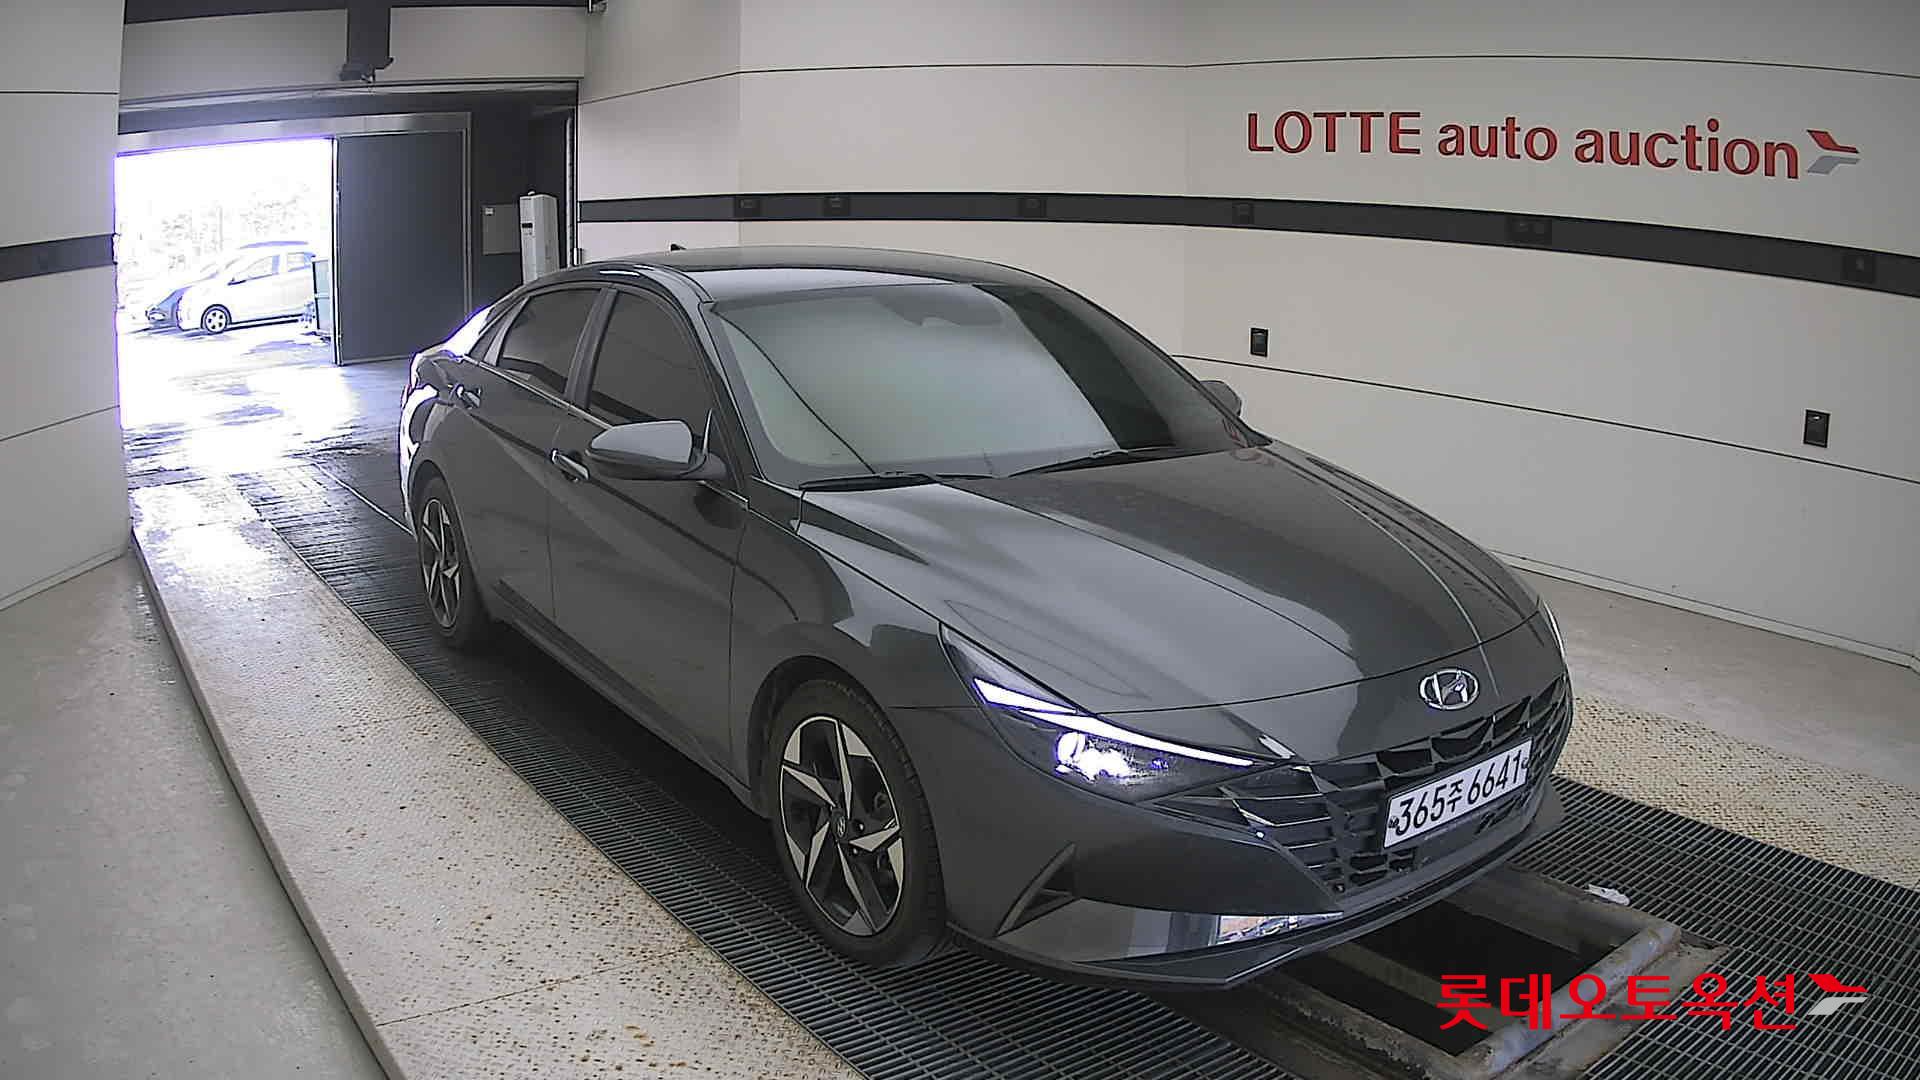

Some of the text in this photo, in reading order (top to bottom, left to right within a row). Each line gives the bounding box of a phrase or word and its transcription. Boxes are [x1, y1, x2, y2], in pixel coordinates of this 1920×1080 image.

[1247, 110, 1800, 179] LOTTE auto auction
